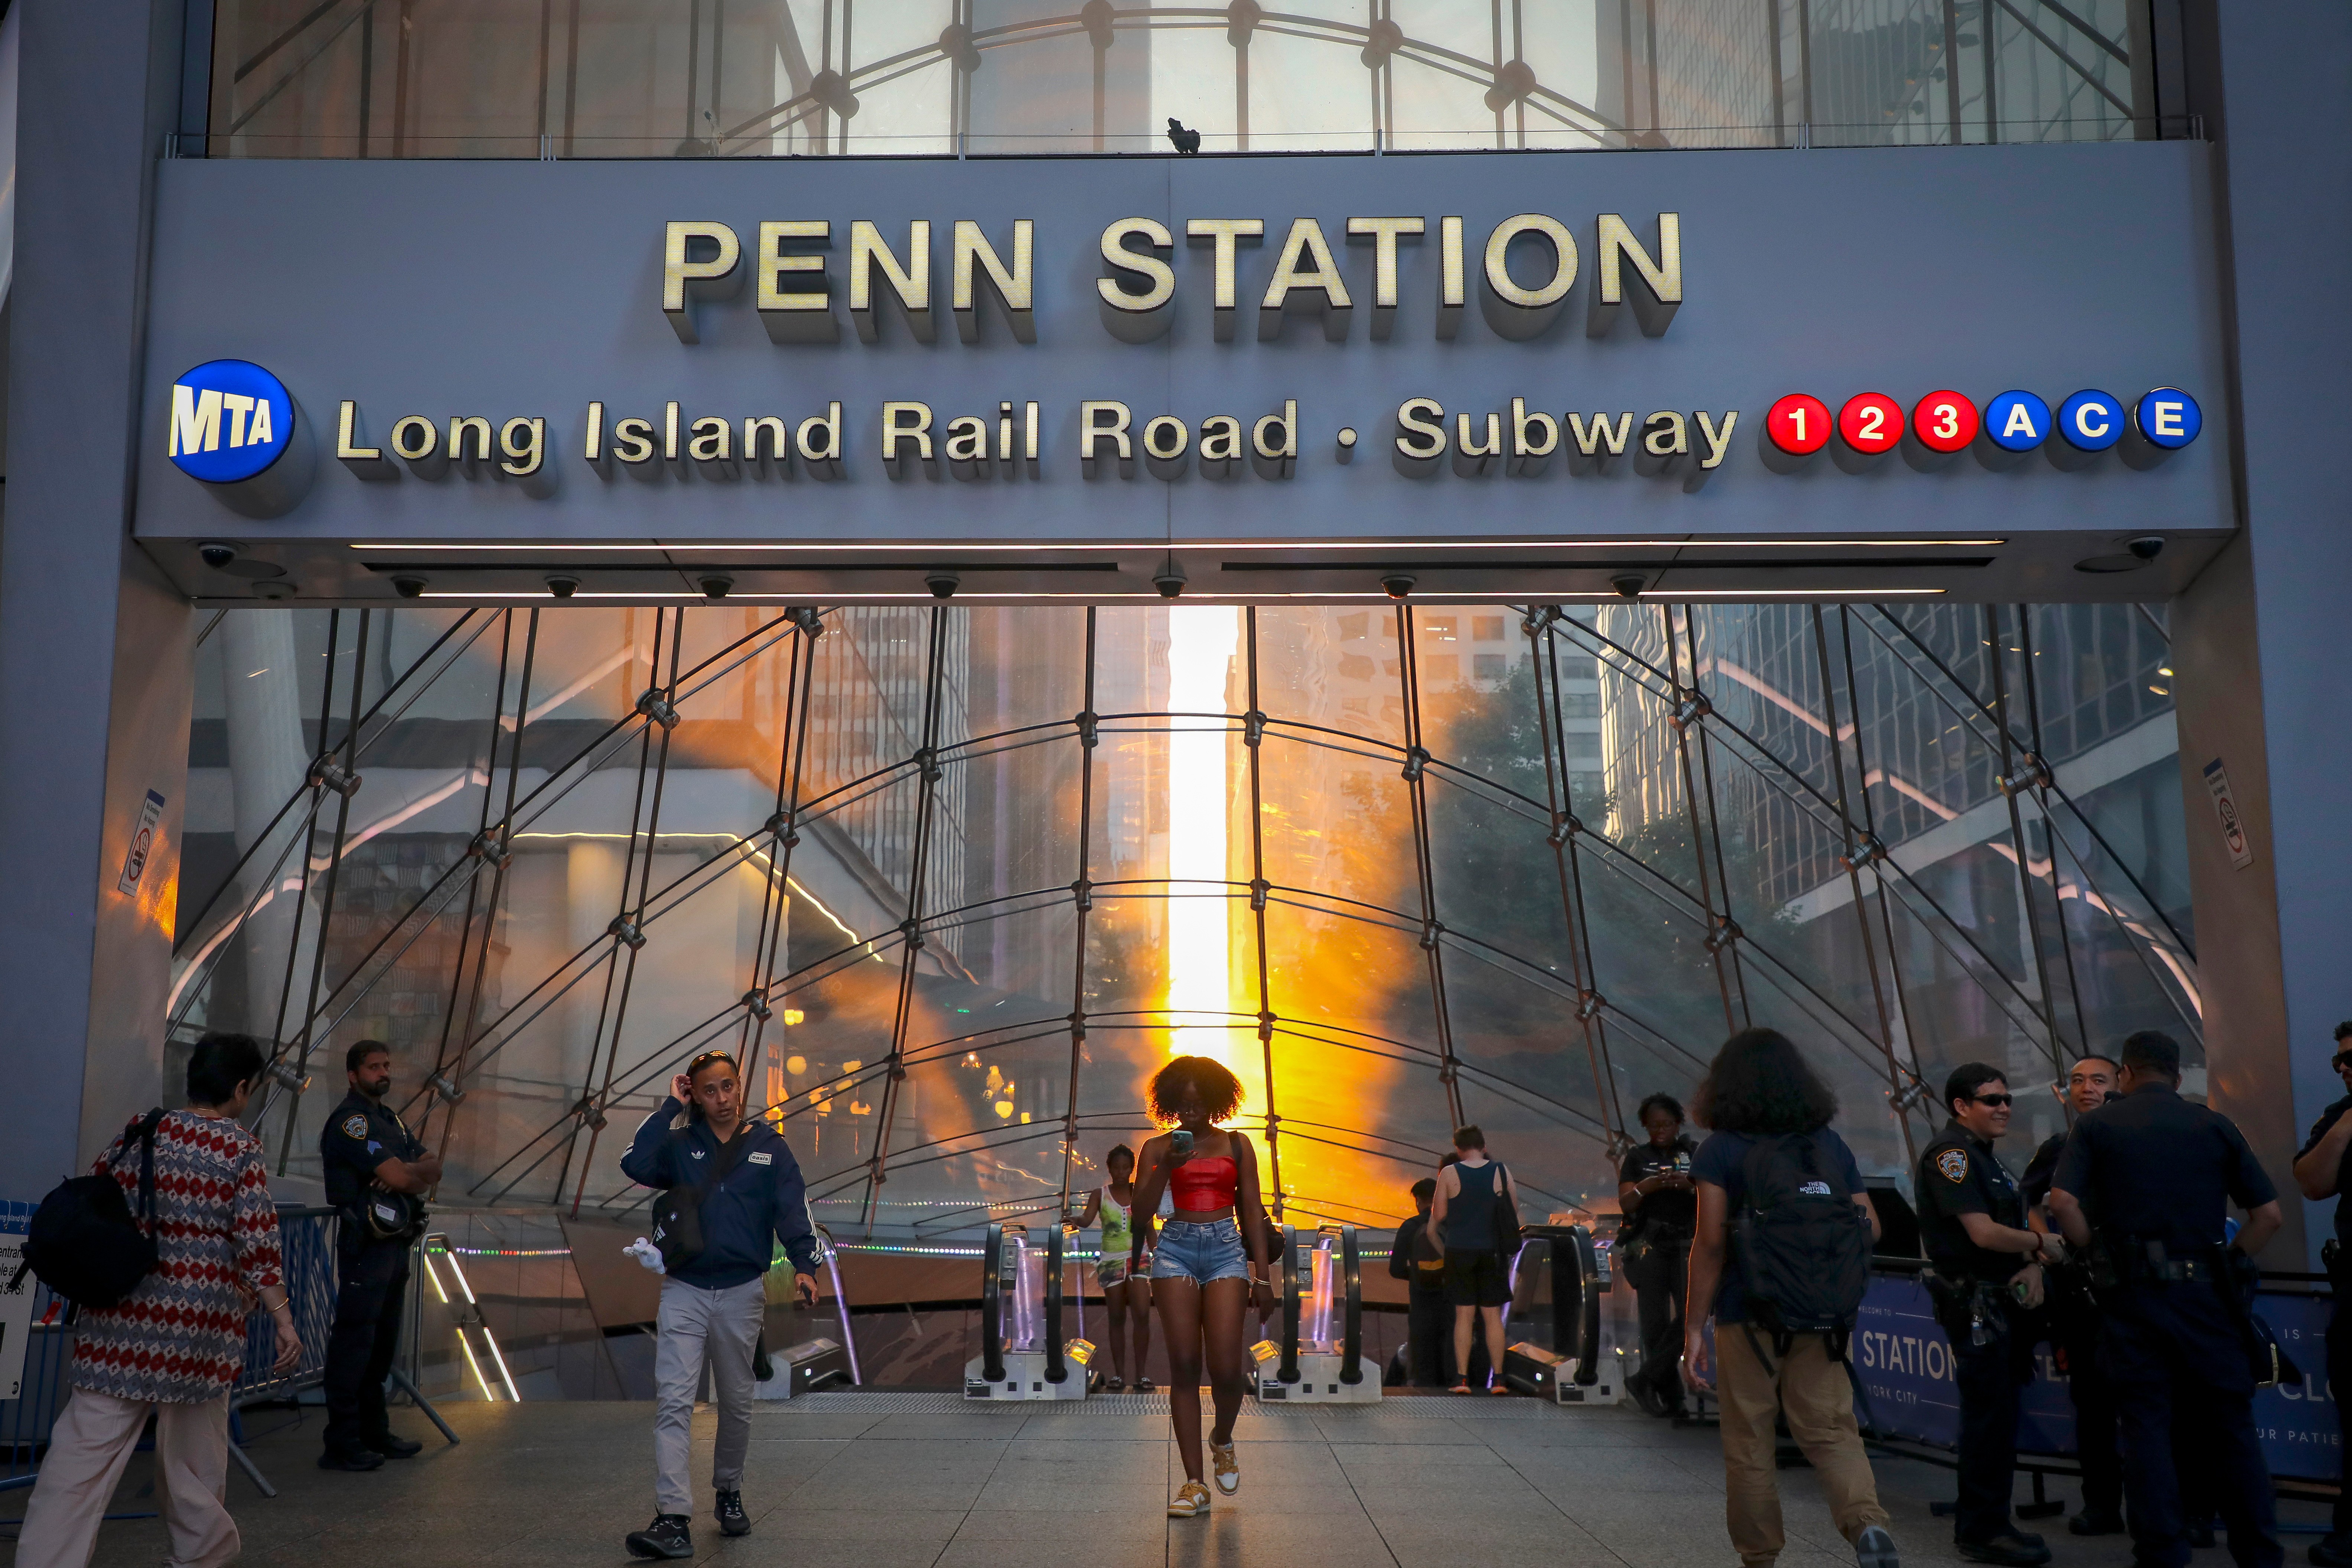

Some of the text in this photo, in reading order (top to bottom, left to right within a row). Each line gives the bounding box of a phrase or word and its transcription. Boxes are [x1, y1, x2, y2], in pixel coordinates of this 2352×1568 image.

[662, 212, 1683, 313] PENN STATION
[168, 384, 273, 457] MTA
[336, 400, 546, 477] Long
[584, 400, 842, 464] Island
[882, 400, 1039, 462] Rail
[1080, 399, 1298, 462] Road
[1395, 397, 1739, 472] Subway
[1788, 402, 2184, 441] 1 2 3 A C E
[2285, 1329, 2300, 1339] IS
[1867, 1384, 1917, 1404] YORK CITY
